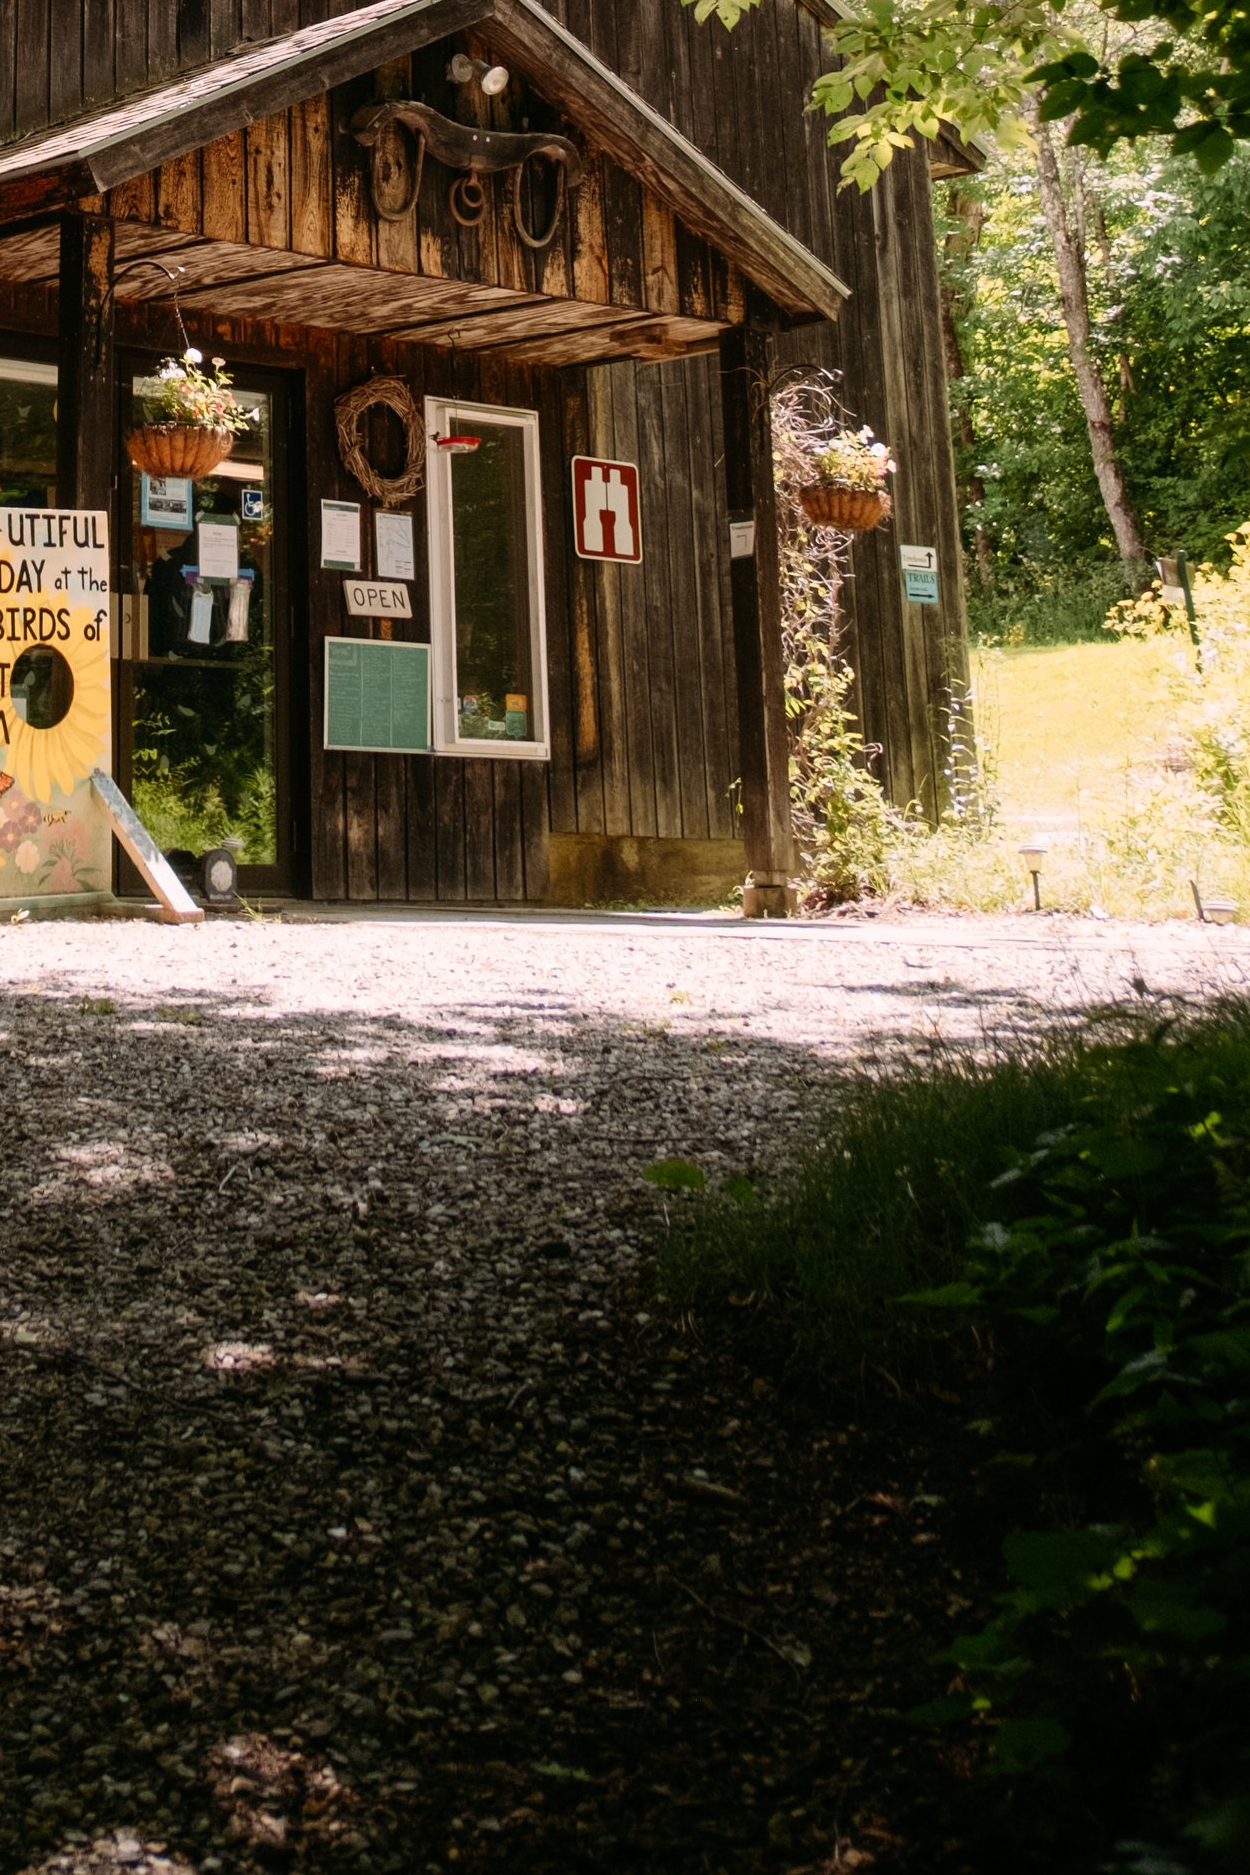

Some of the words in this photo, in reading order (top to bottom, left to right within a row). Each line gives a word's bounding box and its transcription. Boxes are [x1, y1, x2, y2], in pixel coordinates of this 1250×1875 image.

[54, 567, 72, 591] at
[77, 566, 108, 593] the
[908, 572, 935, 585] TRAILS
[353, 587, 406, 609] OPEN
[83, 608, 108, 642] of
